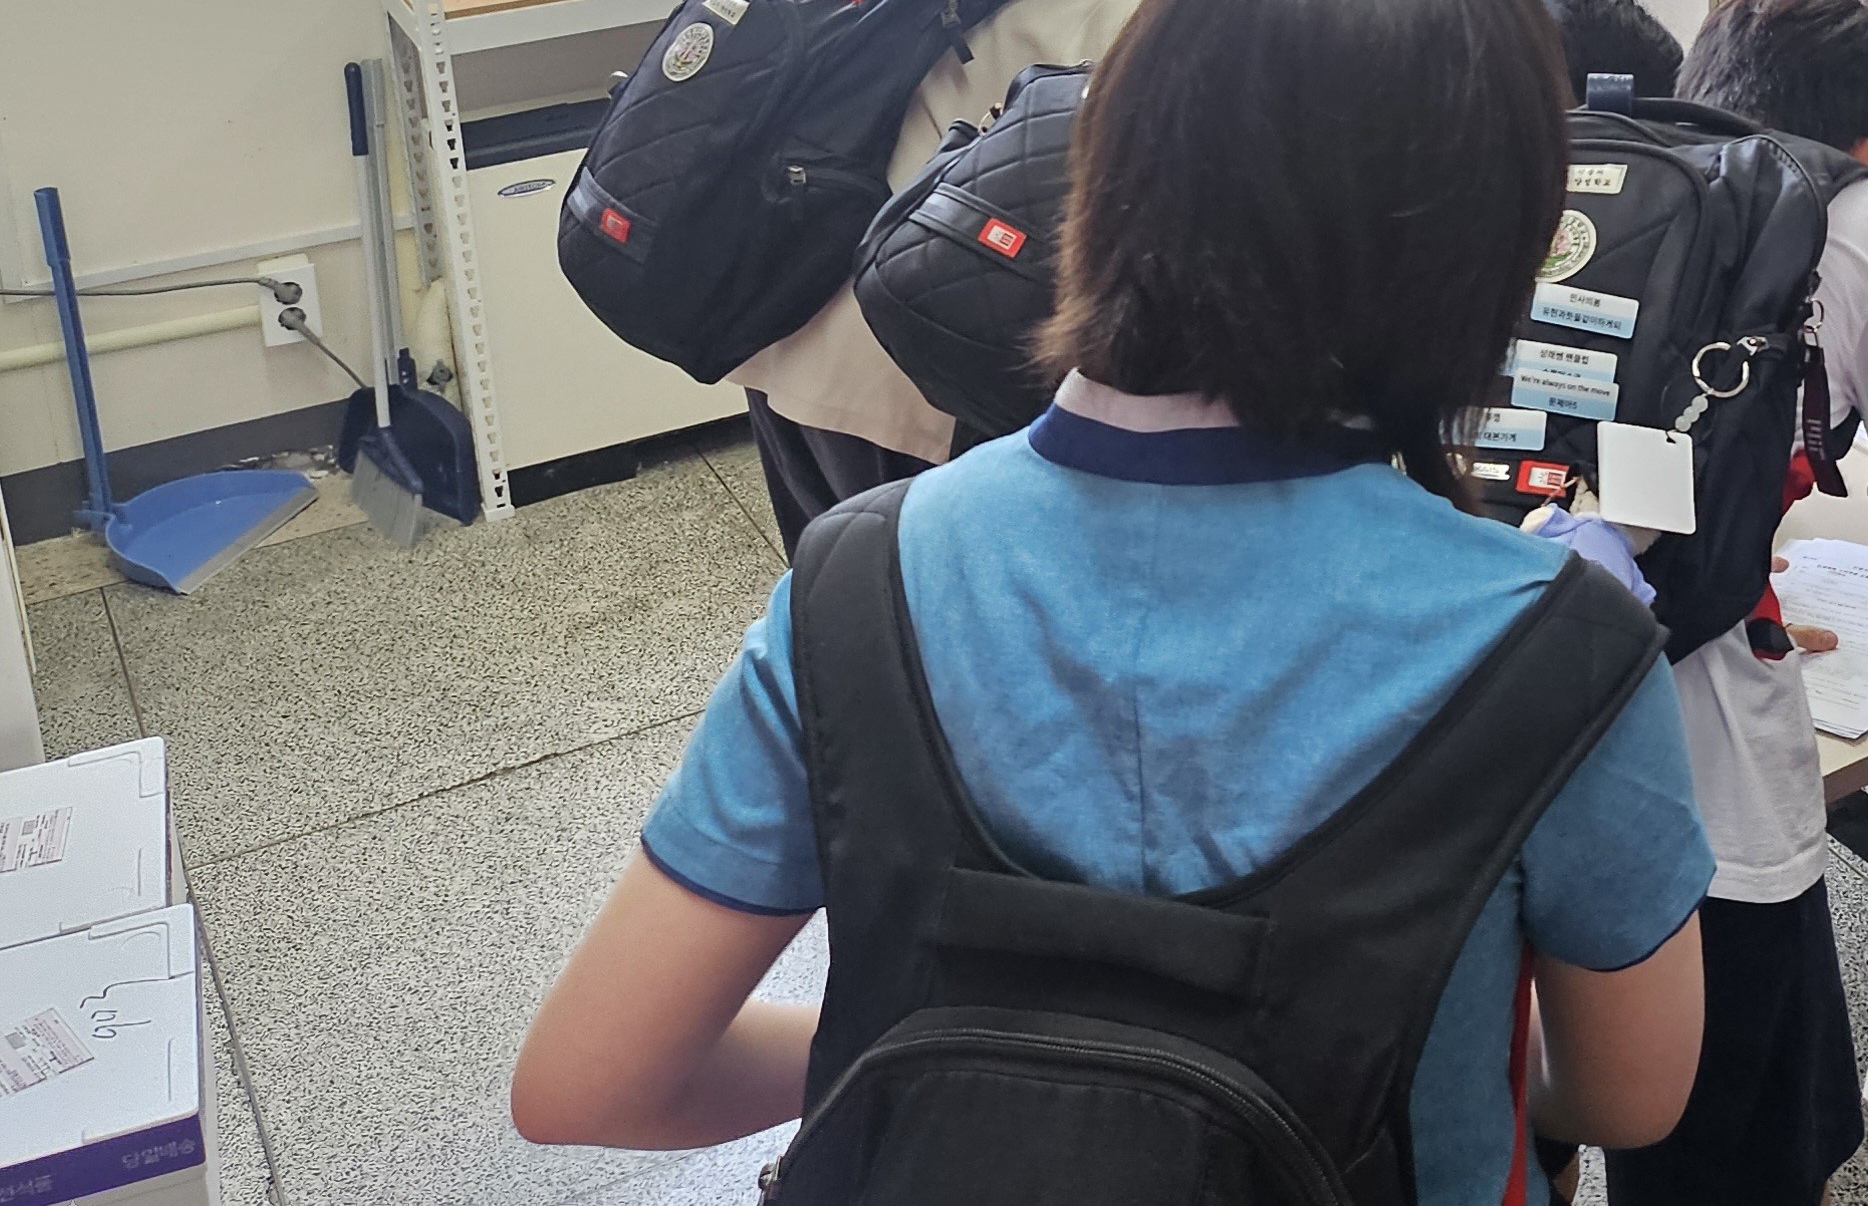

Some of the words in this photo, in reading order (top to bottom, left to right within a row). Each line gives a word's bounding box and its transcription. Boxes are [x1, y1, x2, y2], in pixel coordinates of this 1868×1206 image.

[1521, 374, 1540, 385] We're
[1542, 378, 1565, 391] always
[1578, 384, 1590, 393] the
[1591, 387, 1610, 396] move
[122, 1138, 196, 1169] 당일배송
